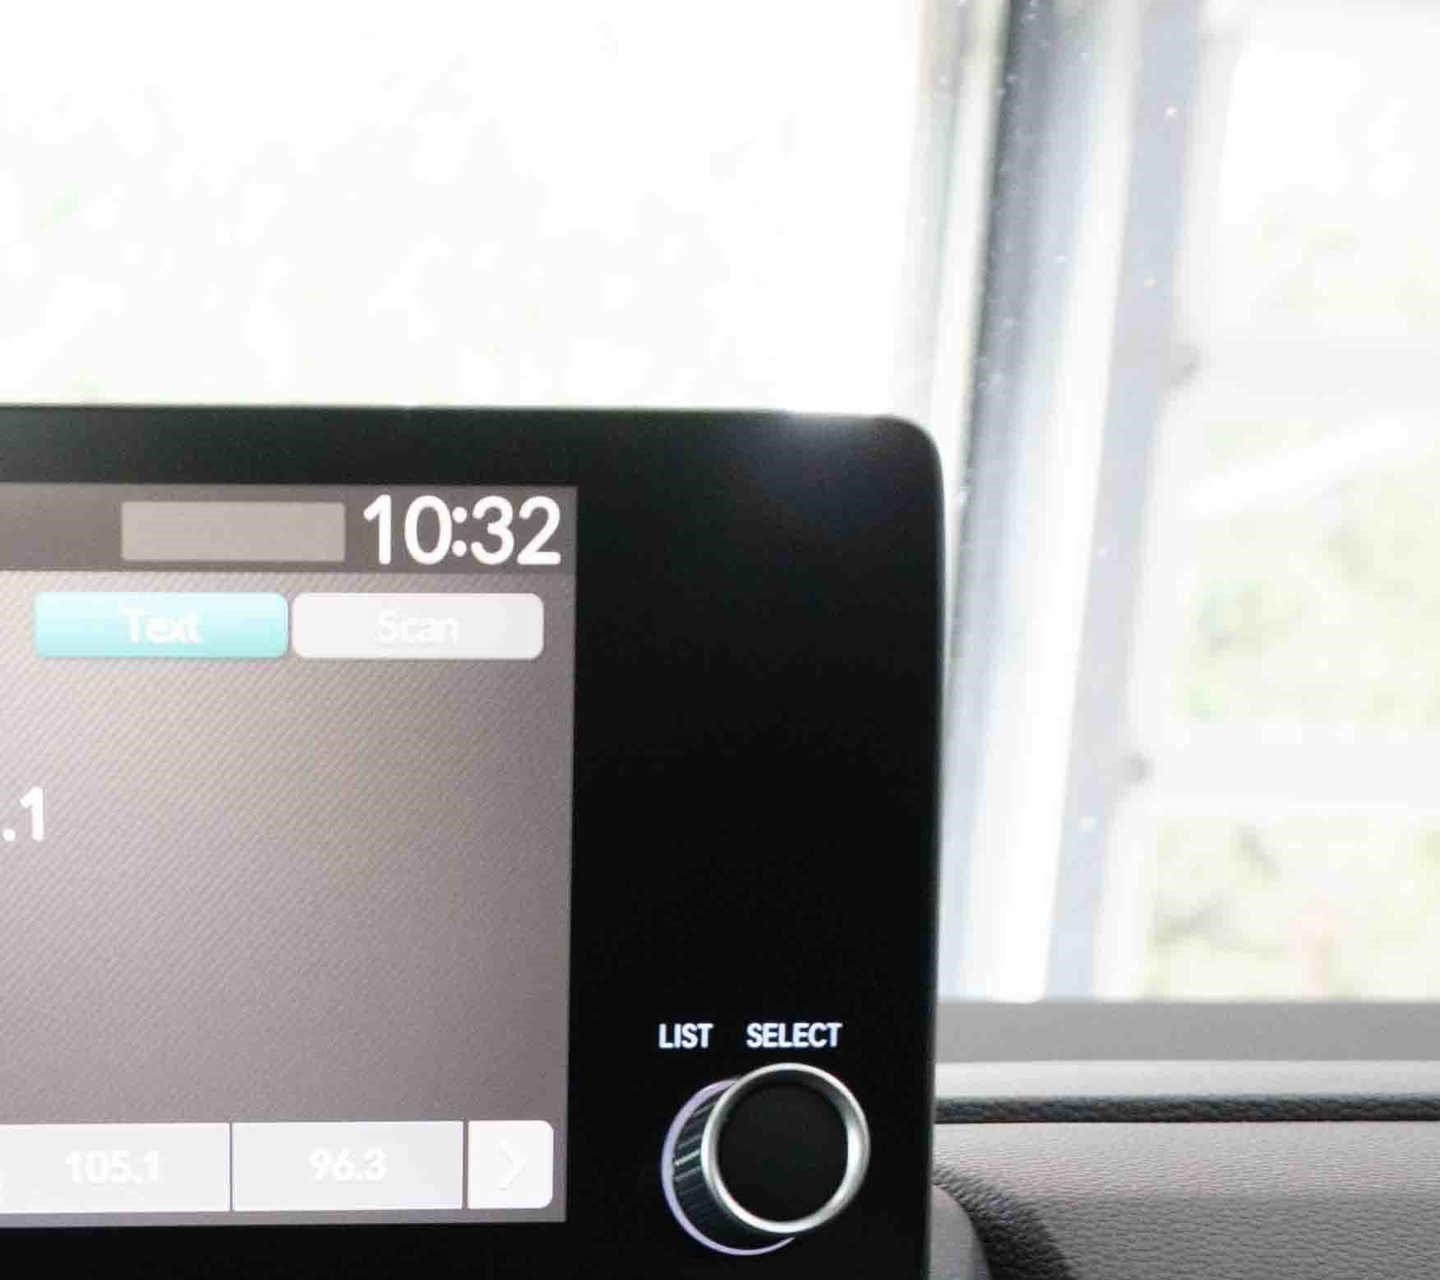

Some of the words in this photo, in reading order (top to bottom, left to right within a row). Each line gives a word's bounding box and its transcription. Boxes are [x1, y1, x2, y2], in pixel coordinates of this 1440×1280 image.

[362, 493, 562, 566] 10:32
[121, 608, 203, 644] Text
[375, 608, 461, 645] Scan
[658, 1022, 714, 1049] LIST
[746, 1022, 843, 1049] SELECT
[64, 1148, 162, 1186] 105.1
[307, 1146, 388, 1184] 96.3
